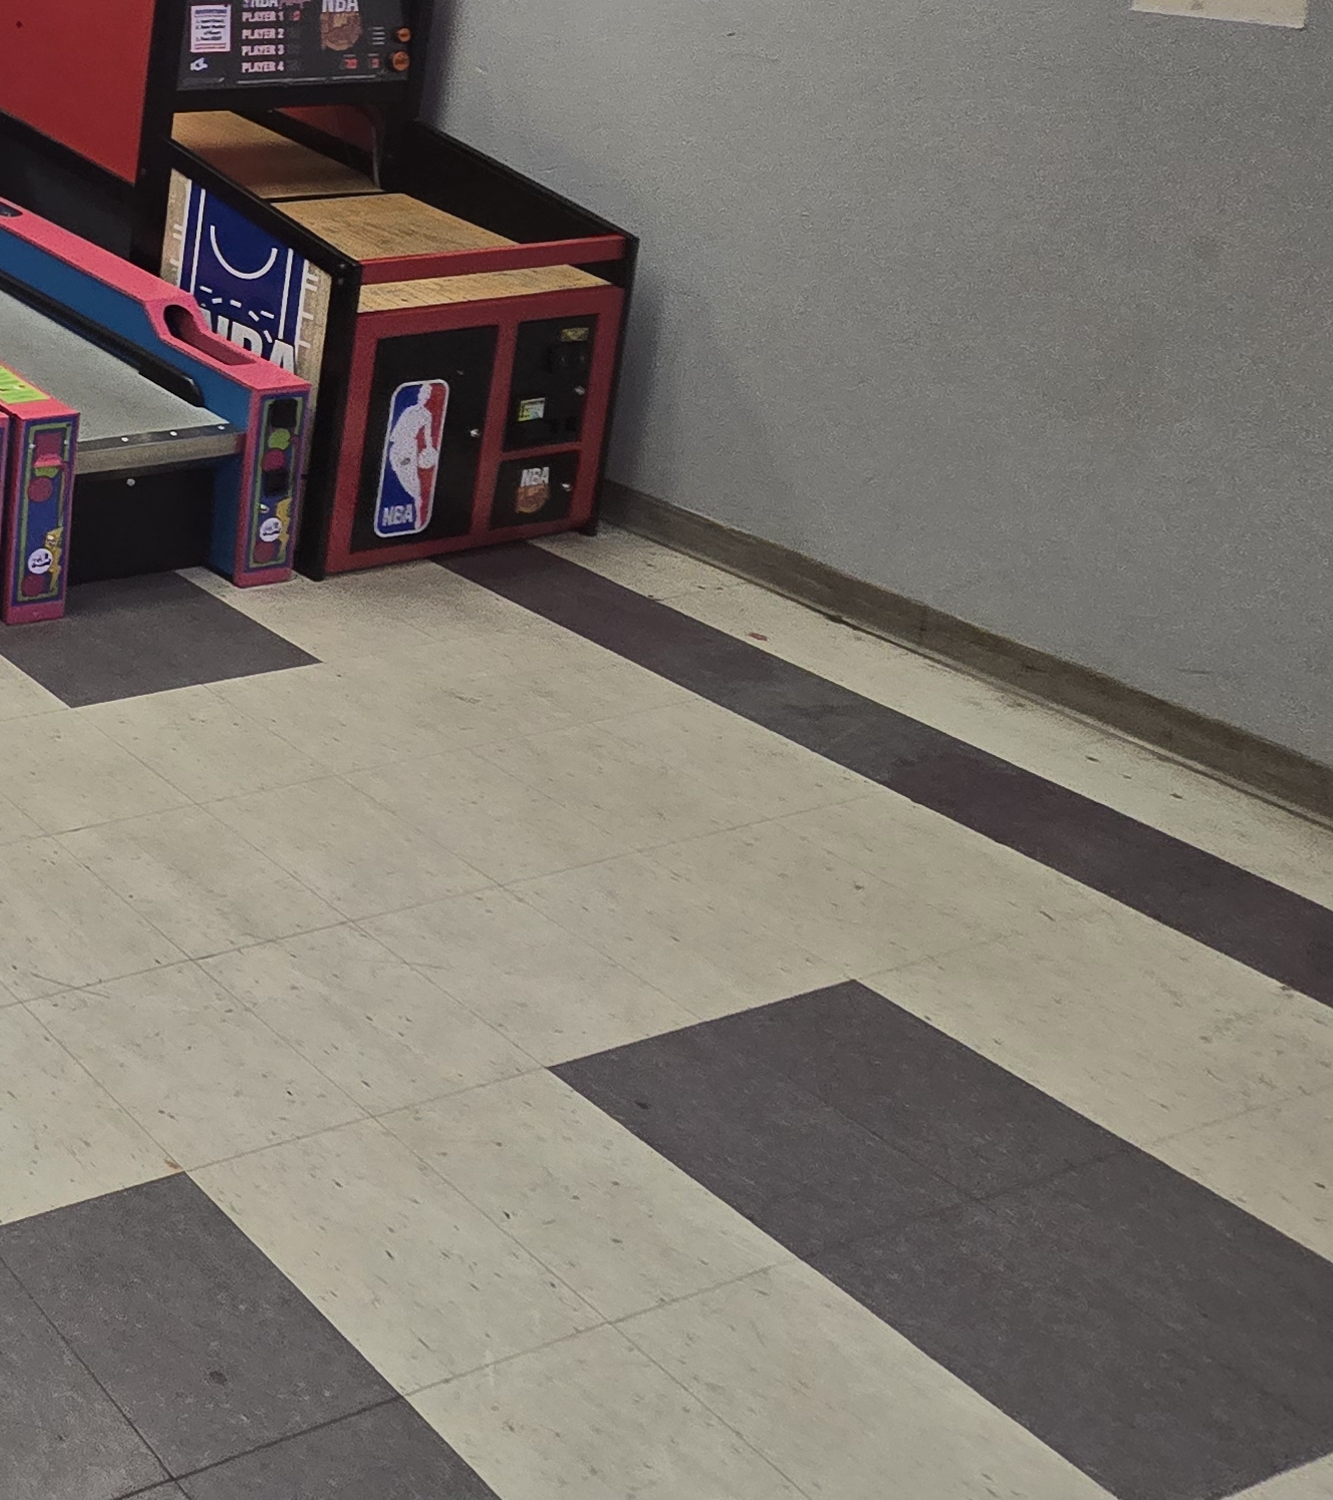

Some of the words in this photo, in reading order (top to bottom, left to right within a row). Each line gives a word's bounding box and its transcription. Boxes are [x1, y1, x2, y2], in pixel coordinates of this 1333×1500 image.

[241, 11, 276, 22] PLAYER
[276, 11, 285, 22] 1
[241, 28, 276, 39] PLAYER
[276, 28, 285, 39] 2
[241, 45, 276, 56] PLAYER
[276, 45, 285, 56] 3
[241, 62, 276, 73] PLAYER
[276, 62, 285, 73] 4
[382, 503, 414, 527] NBA
